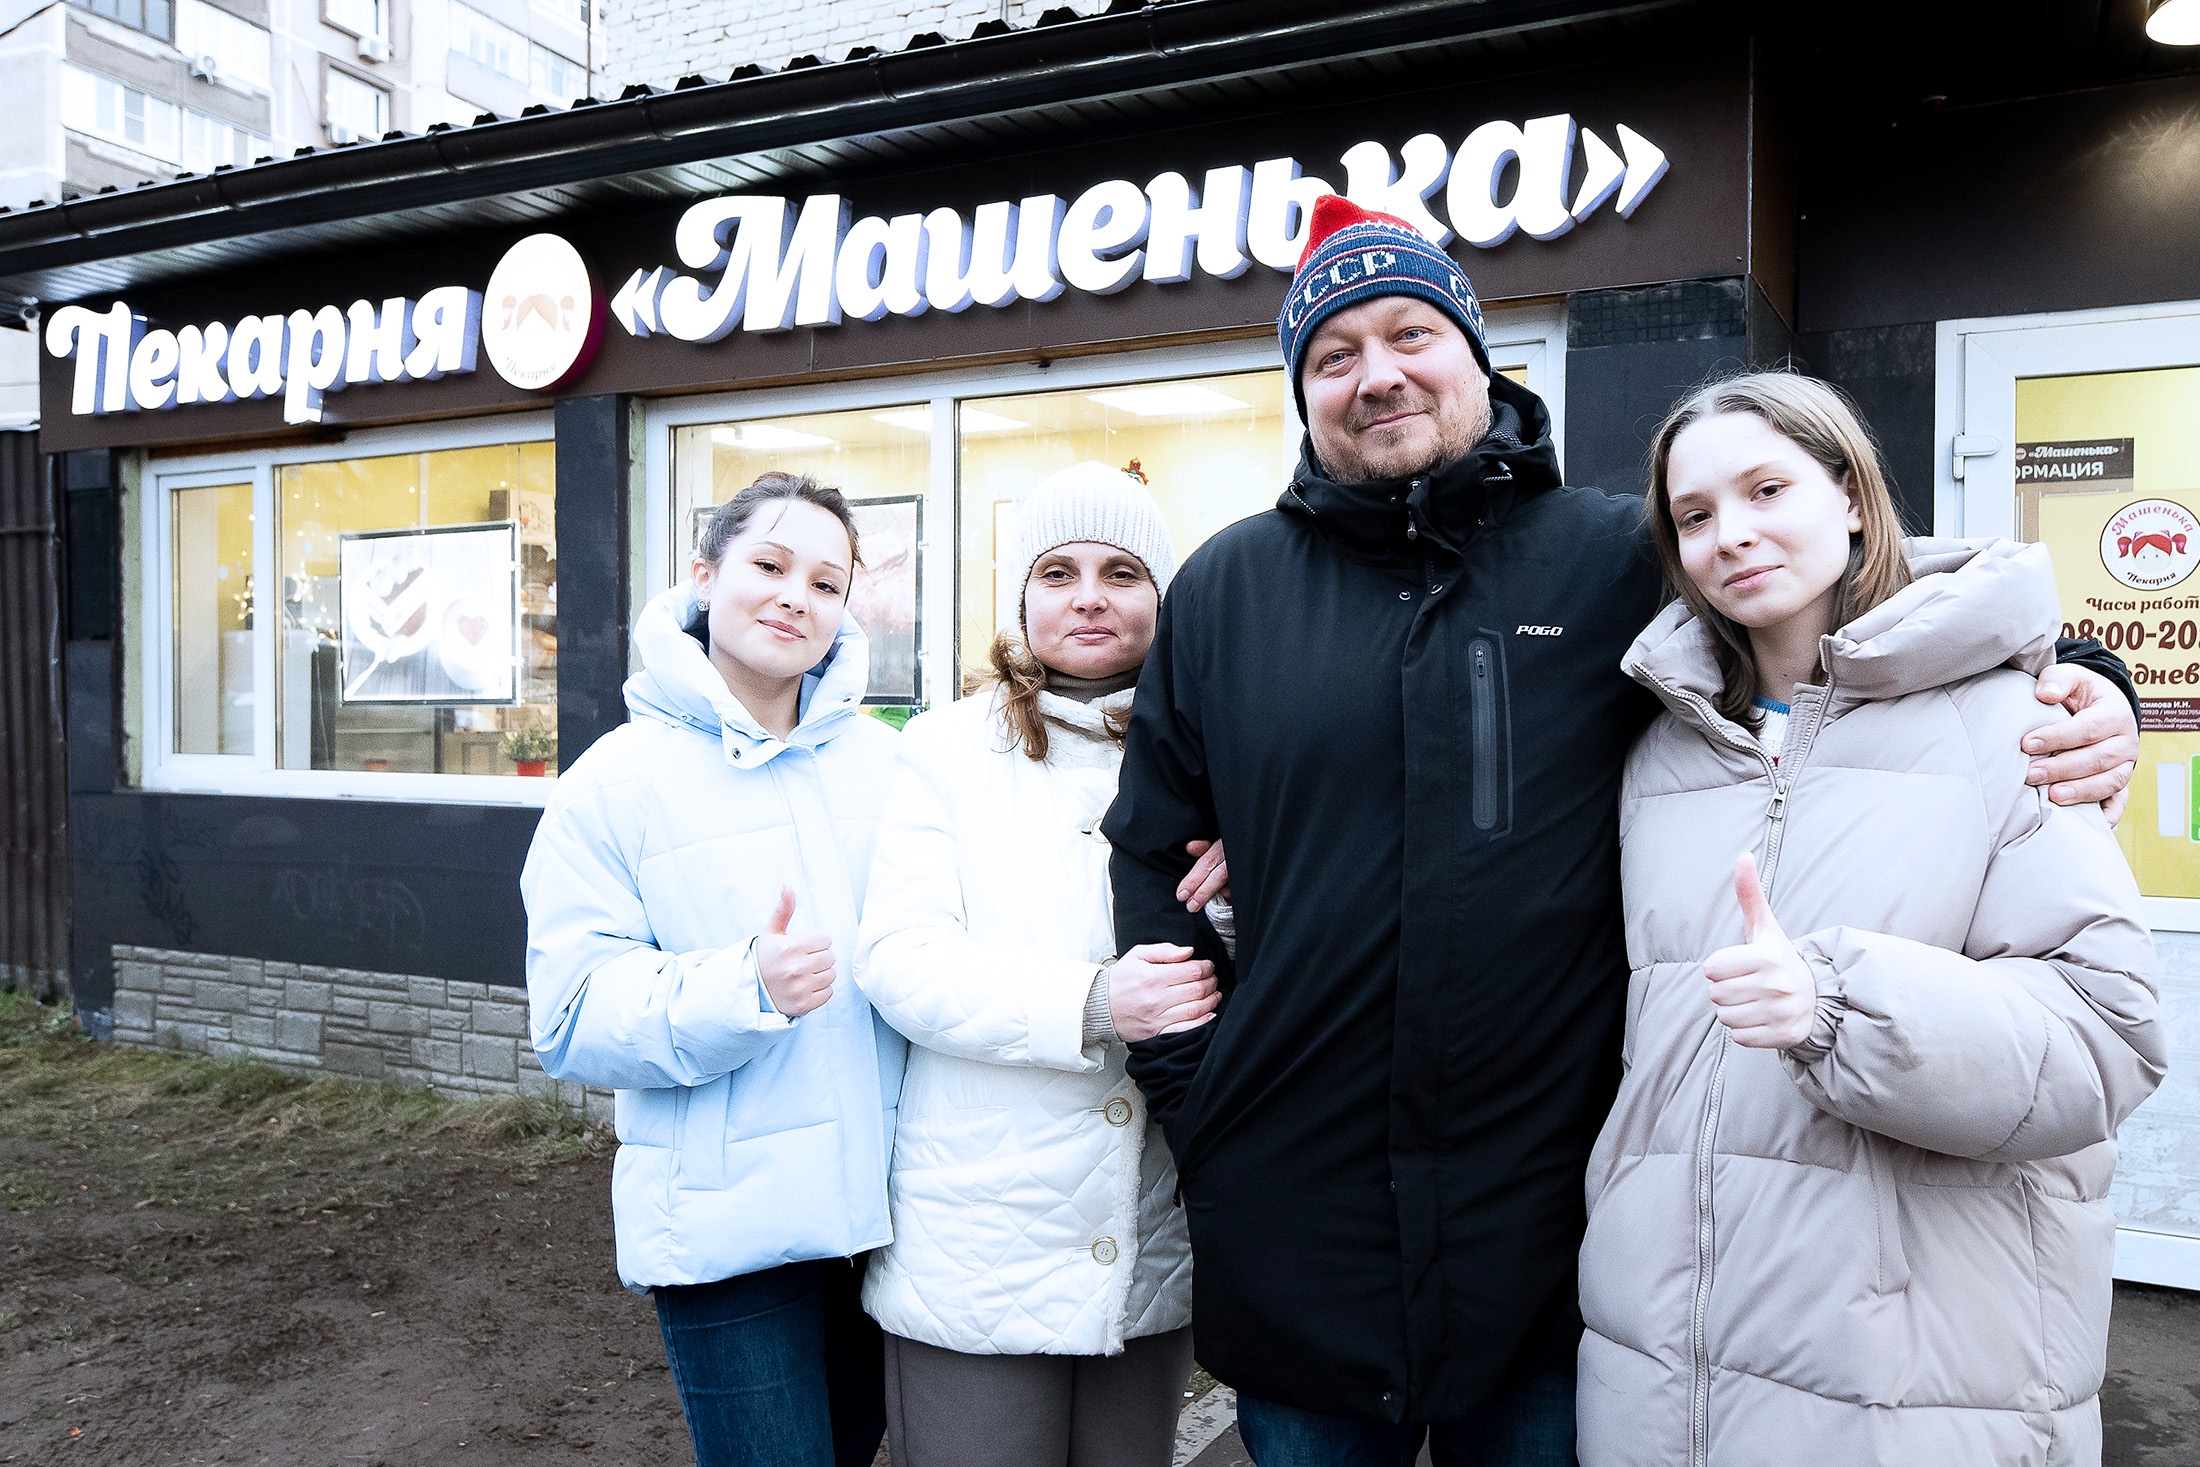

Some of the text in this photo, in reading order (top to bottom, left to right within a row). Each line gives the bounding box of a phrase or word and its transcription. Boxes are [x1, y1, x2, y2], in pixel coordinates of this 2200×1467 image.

[46, 114, 1668, 424] Пекарня «Машенька»
[1288, 249, 1396, 330] СССР
[2111, 505, 2194, 536] Машенька
[2127, 571, 2176, 586] Пекарня
[2086, 597, 2136, 611] Часы
[1515, 625, 1564, 637] POGO
[2060, 619, 2200, 650] 08:00-20
